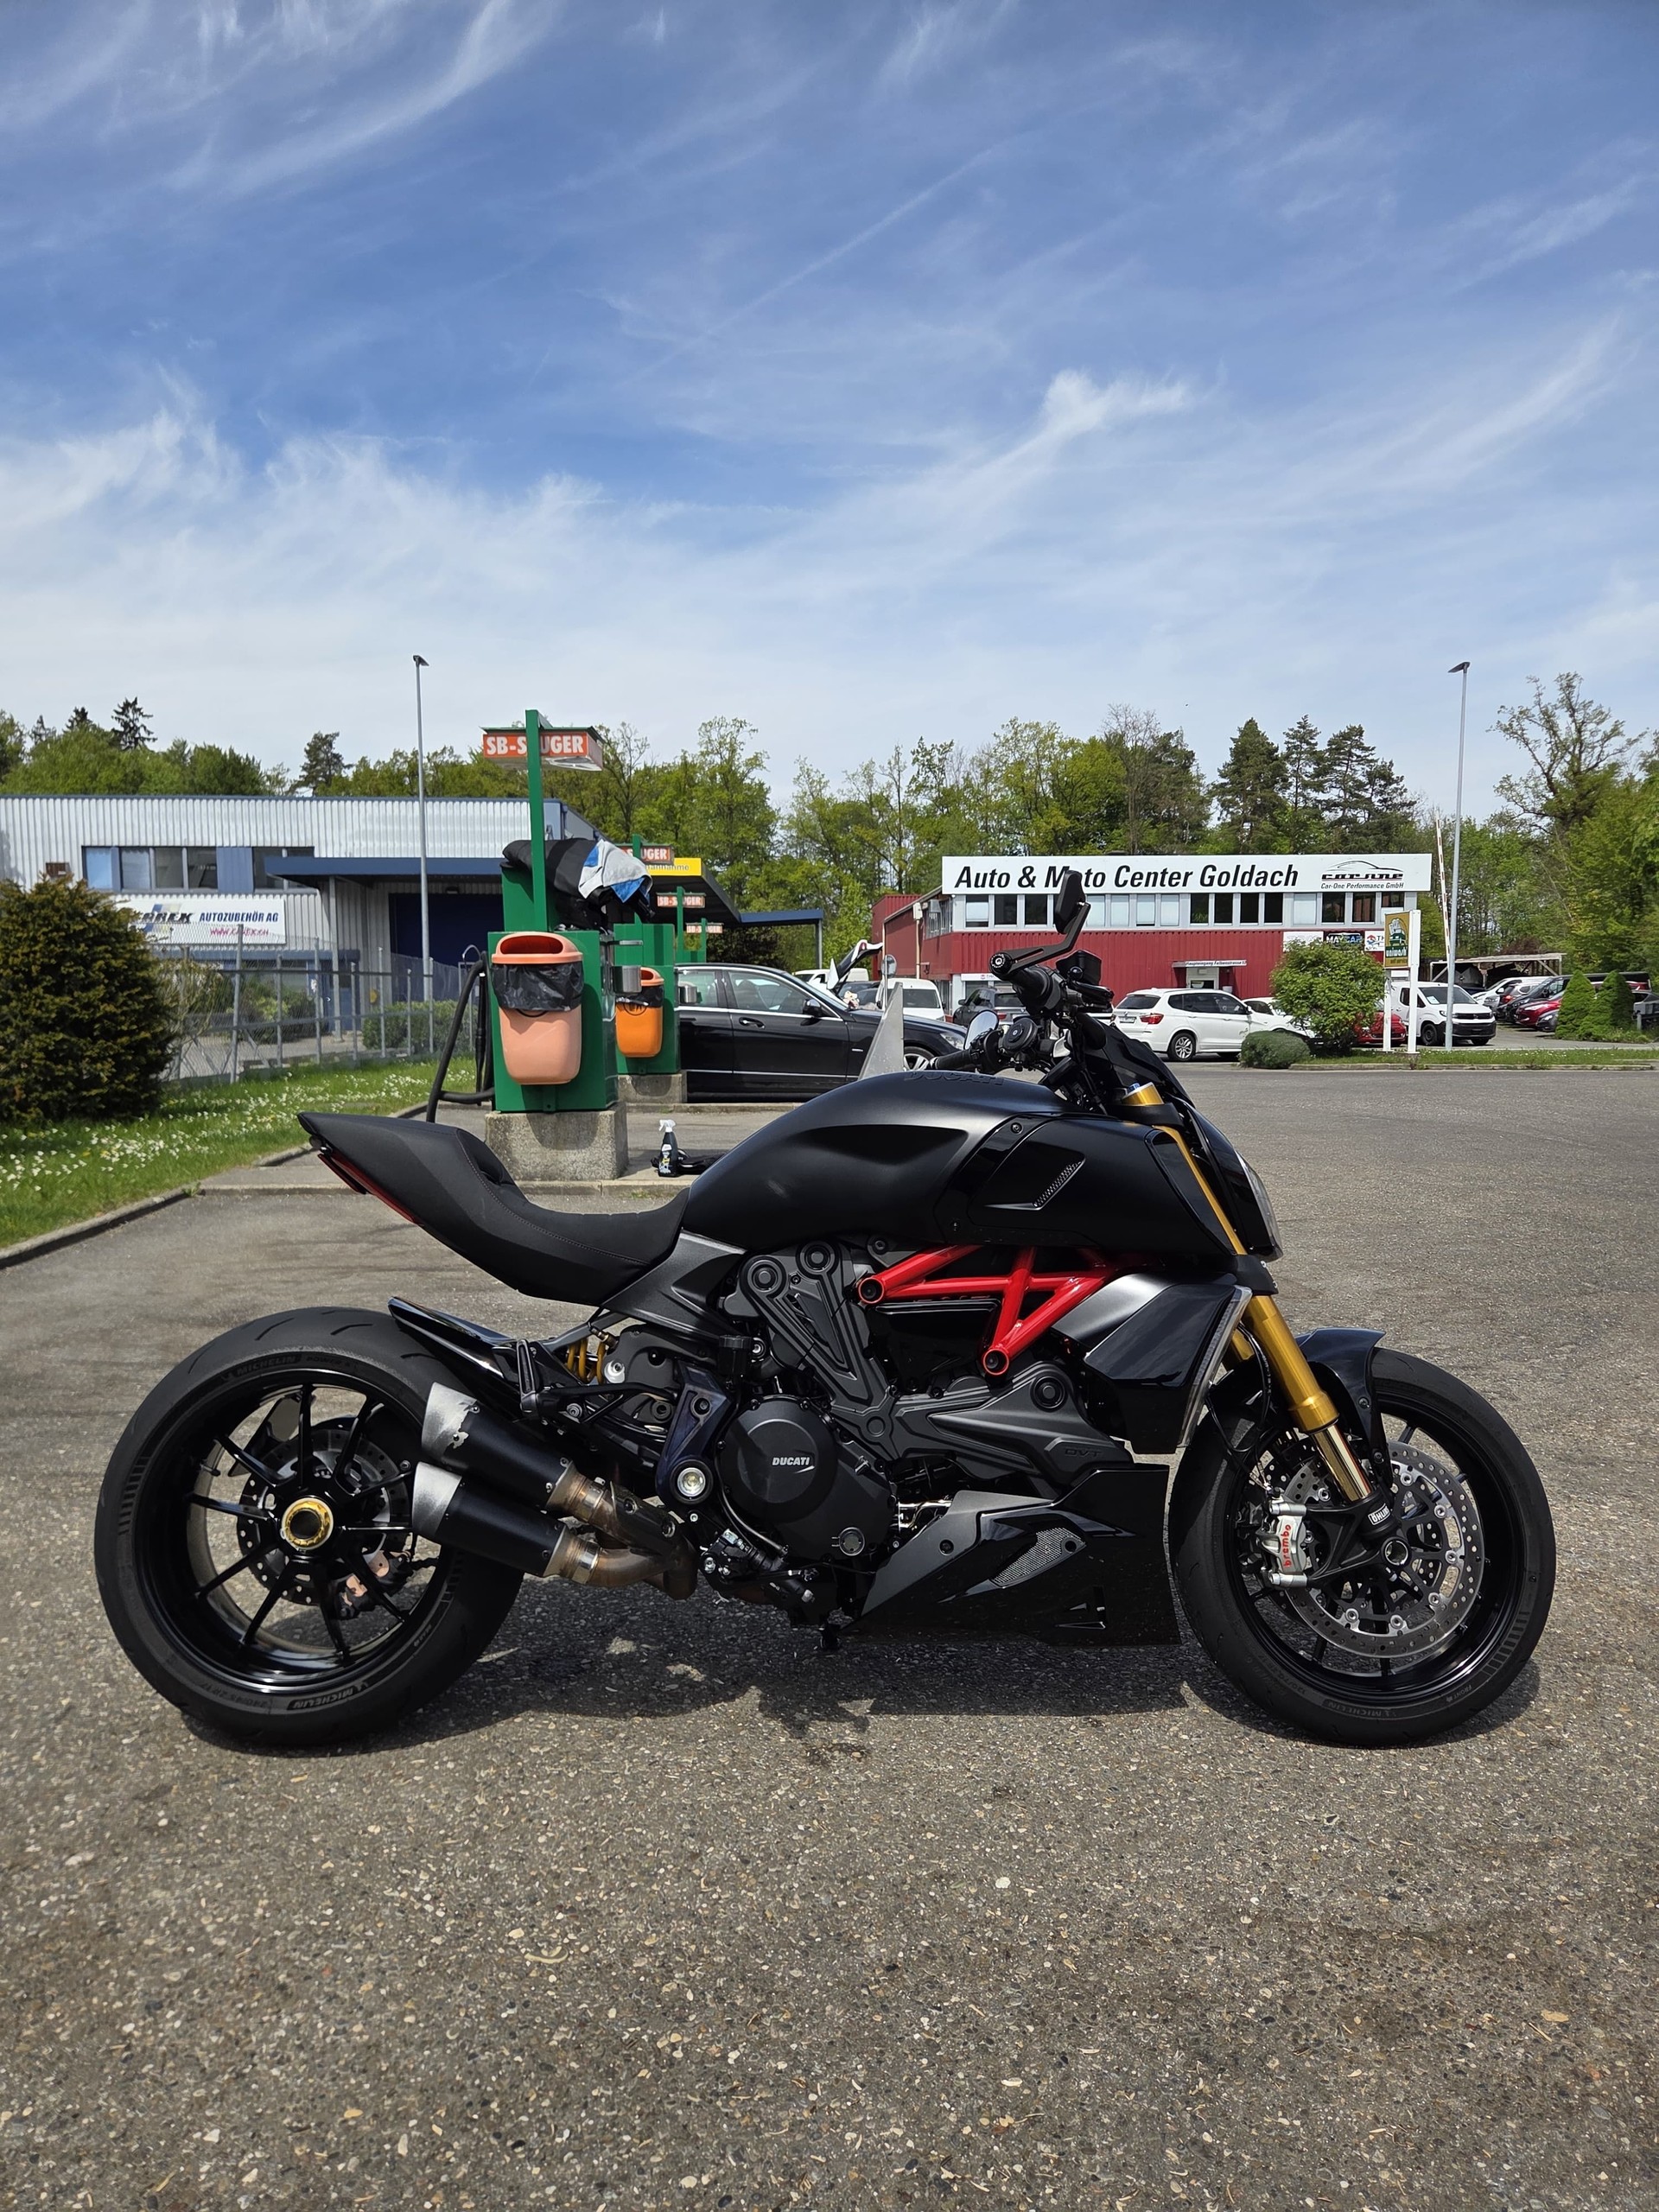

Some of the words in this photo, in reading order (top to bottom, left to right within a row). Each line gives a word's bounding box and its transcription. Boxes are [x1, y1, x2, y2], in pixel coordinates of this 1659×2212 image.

[486, 735, 584, 755] SB-SUGER
[954, 866, 1011, 888] Auto
[1017, 865, 1037, 888] &
[1045, 866, 1106, 888] Mto
[1114, 865, 1193, 888] Center
[1199, 864, 1299, 887] Goldach
[658, 896, 701, 907] SB-SUGER
[199, 910, 264, 923] AUTOZUBEHÖR
[265, 912, 279, 923] AG
[687, 925, 722, 933] SB-SUGER
[236, 1355, 296, 1376] MICHELIN
[772, 1457, 810, 1466] DUCATI
[1280, 1523, 1293, 1568] brembo
[292, 1687, 354, 1710] MICHELIN
[1327, 1700, 1382, 1717] MICHELIN
